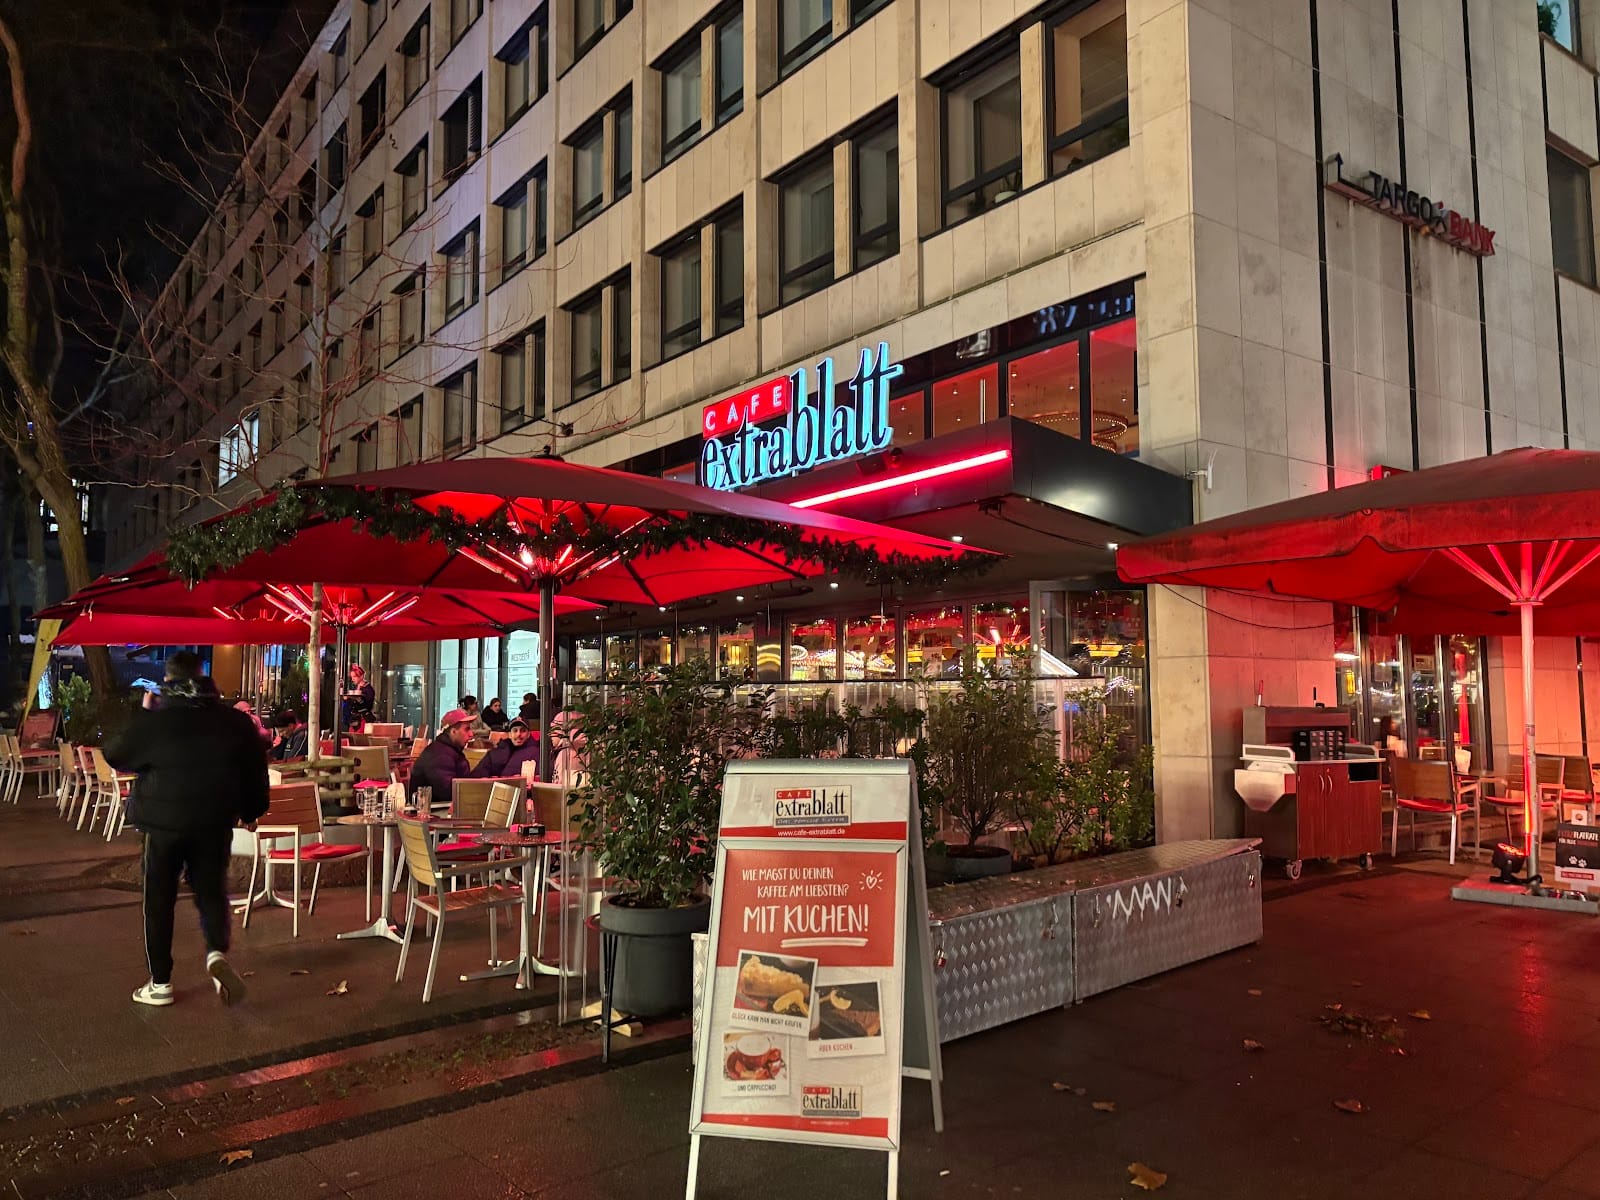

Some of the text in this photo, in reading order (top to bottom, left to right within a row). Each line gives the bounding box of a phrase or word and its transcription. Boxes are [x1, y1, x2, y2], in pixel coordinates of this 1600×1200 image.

[701, 341, 904, 490] extrablatt
[705, 384, 783, 431] CAFE
[776, 789, 848, 817] extrablatt
[777, 828, 846, 837] www.cafe-extrablatt.de
[742, 867, 834, 881] WIE MAGST DU DEINEN
[757, 884, 850, 898] KAFFEE AM LIEBSTEN?
[743, 904, 869, 934] MIT KUCHEN!
[760, 1016, 770, 1025] MAN
[802, 1087, 858, 1110] extrablatt
